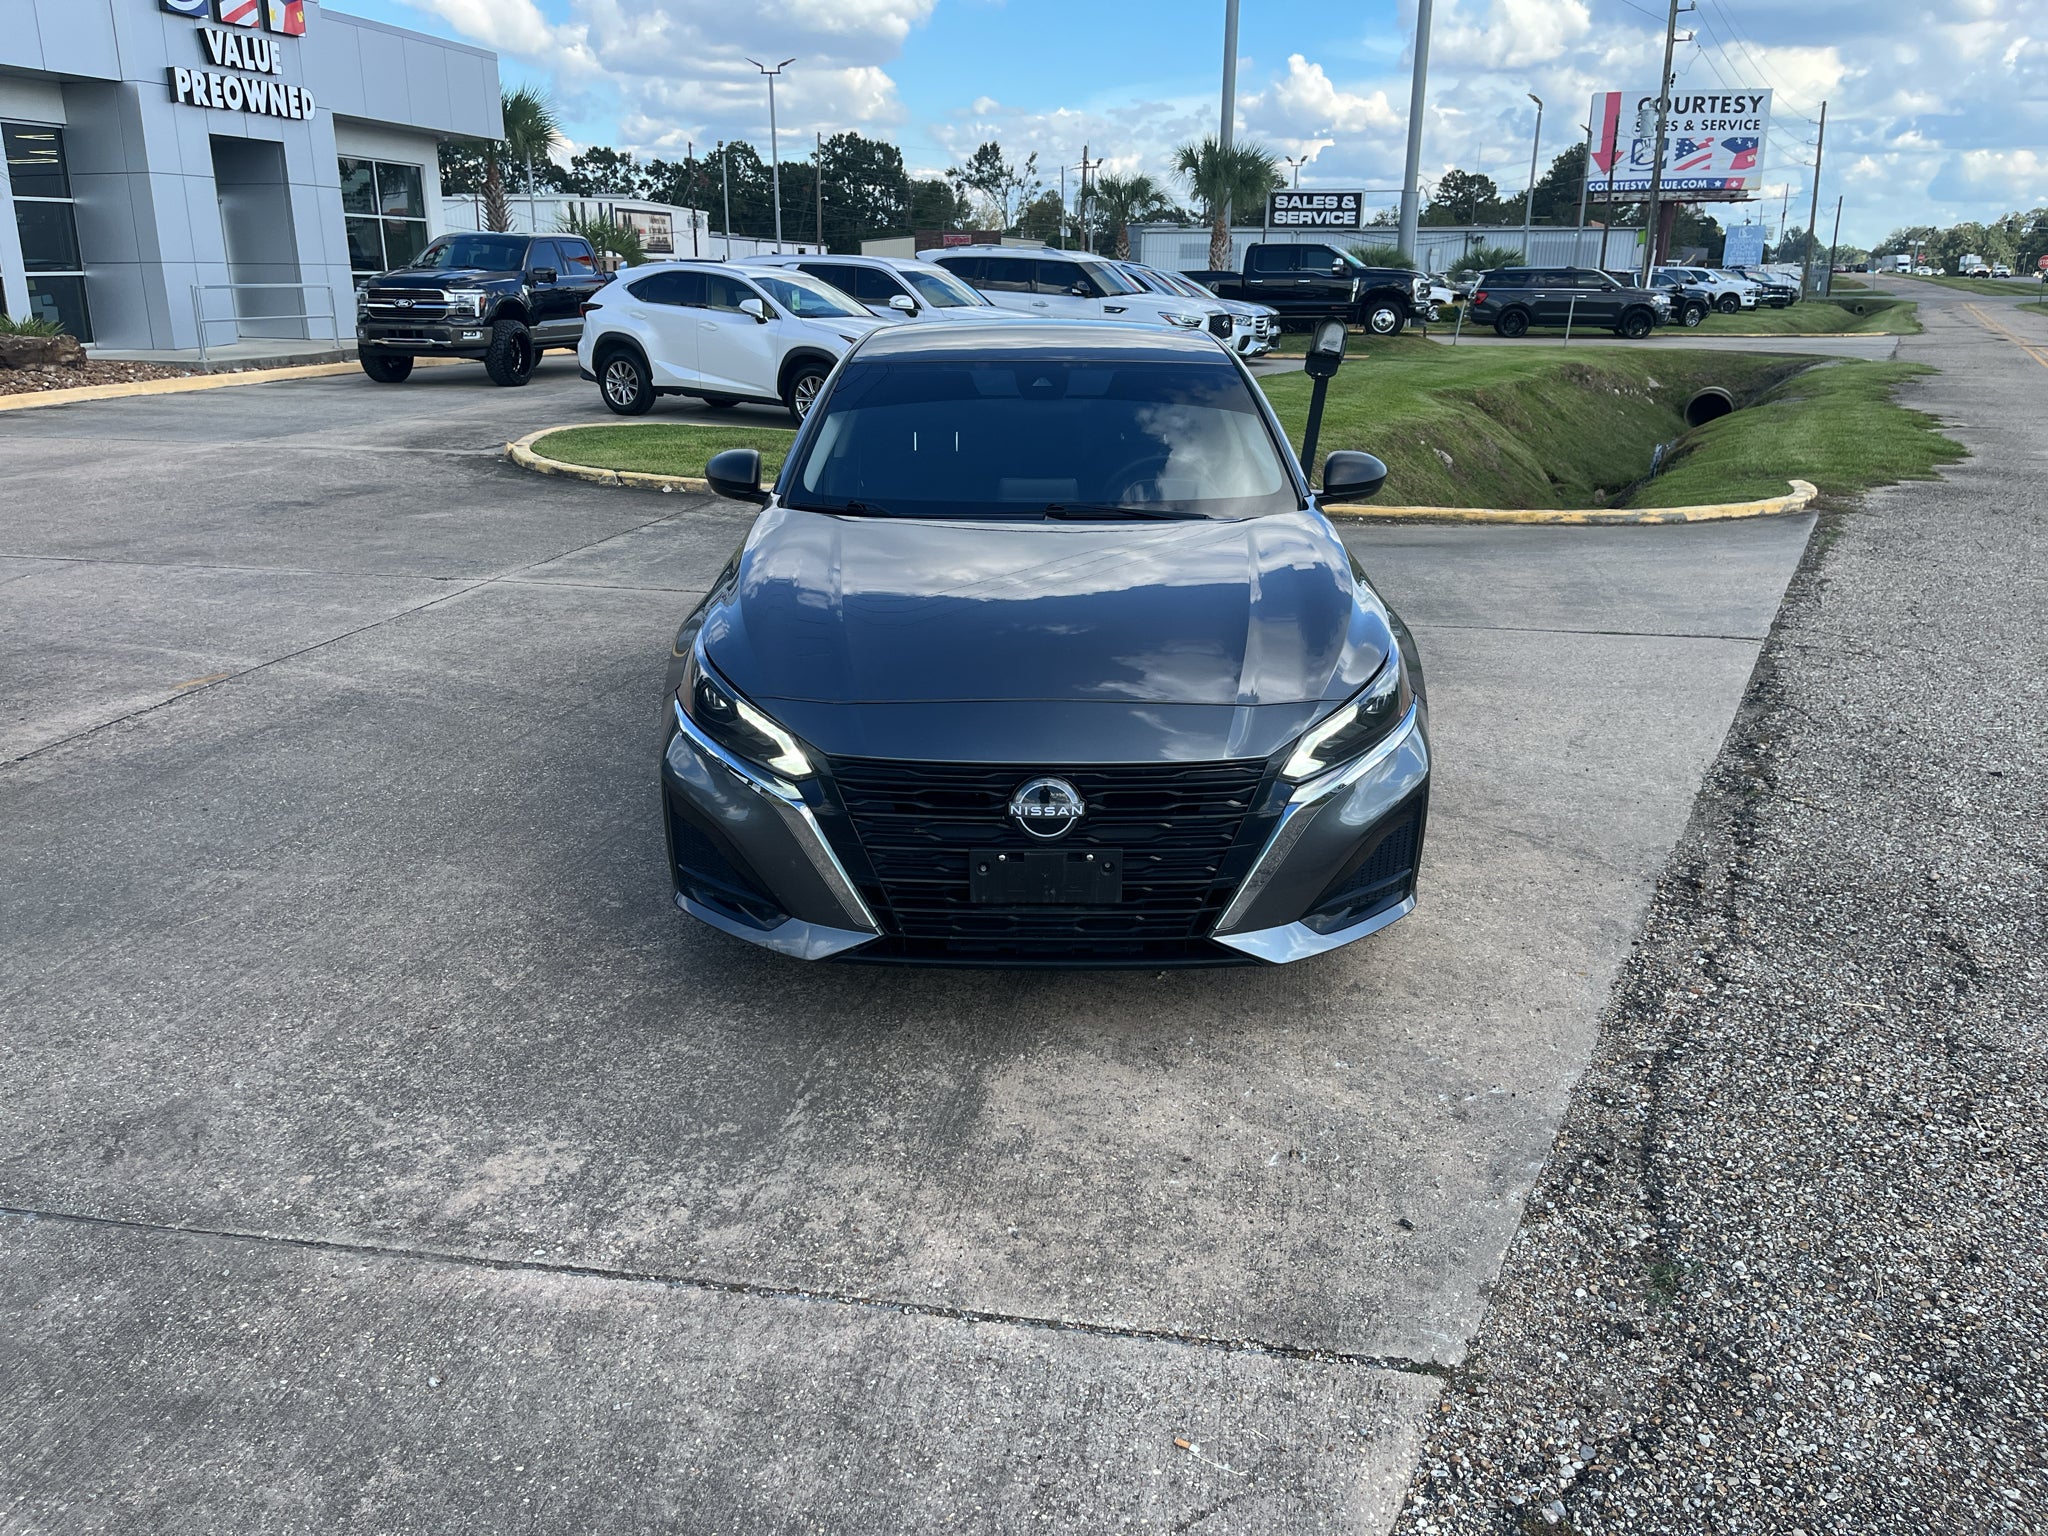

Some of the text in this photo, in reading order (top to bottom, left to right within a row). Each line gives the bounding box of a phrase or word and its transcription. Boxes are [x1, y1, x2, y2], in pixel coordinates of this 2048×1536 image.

[202, 28, 283, 75] VALUE
[172, 66, 317, 121] PREOWNED
[1637, 95, 1765, 115] COURTESY
[1684, 119, 1695, 131] &
[1700, 119, 1761, 131] SERVICE
[1588, 179, 1708, 192] COURTESYVLUE.COM
[1274, 195, 1357, 209] SALES &
[1273, 211, 1357, 225] SERVICE
[1010, 805, 1083, 816] NISSAN
